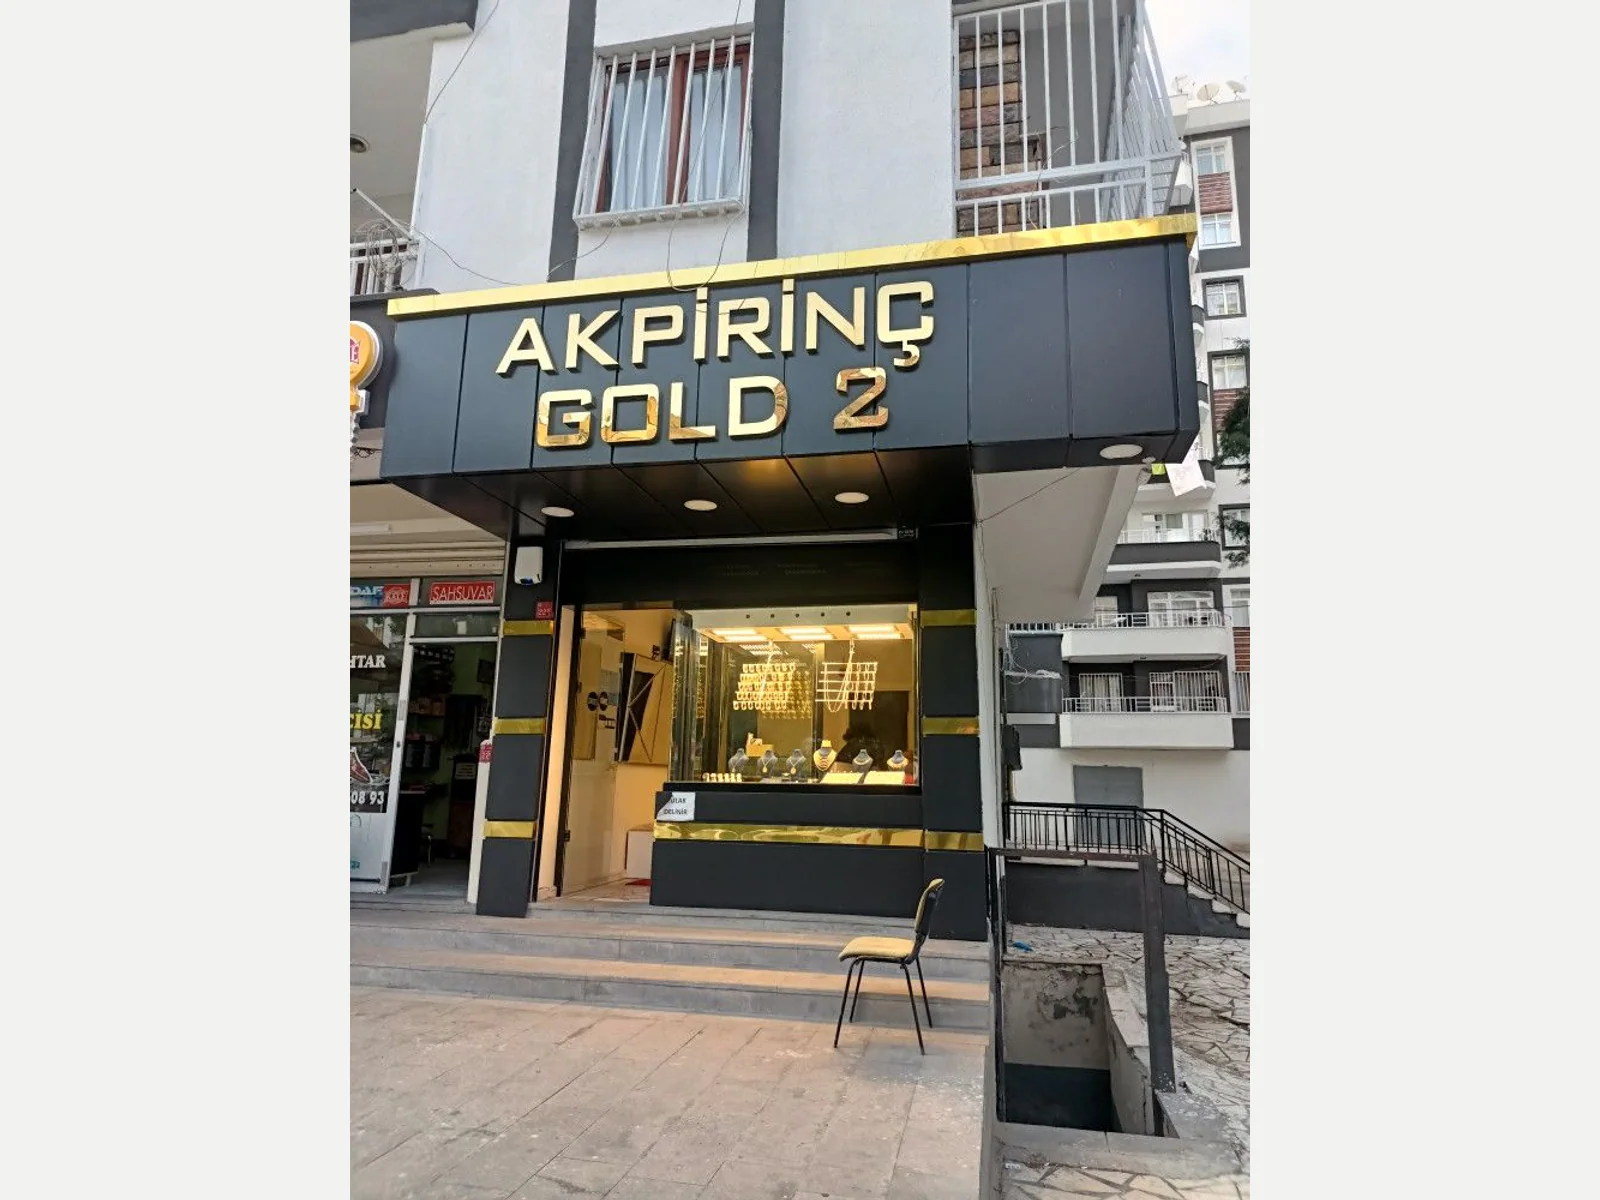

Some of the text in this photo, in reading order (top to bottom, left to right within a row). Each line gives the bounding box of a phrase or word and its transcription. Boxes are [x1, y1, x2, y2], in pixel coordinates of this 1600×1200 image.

[495, 278, 936, 375] AKPİRİNÇ
[537, 365, 890, 449] GOLD 2
[369, 788, 385, 805] 93
